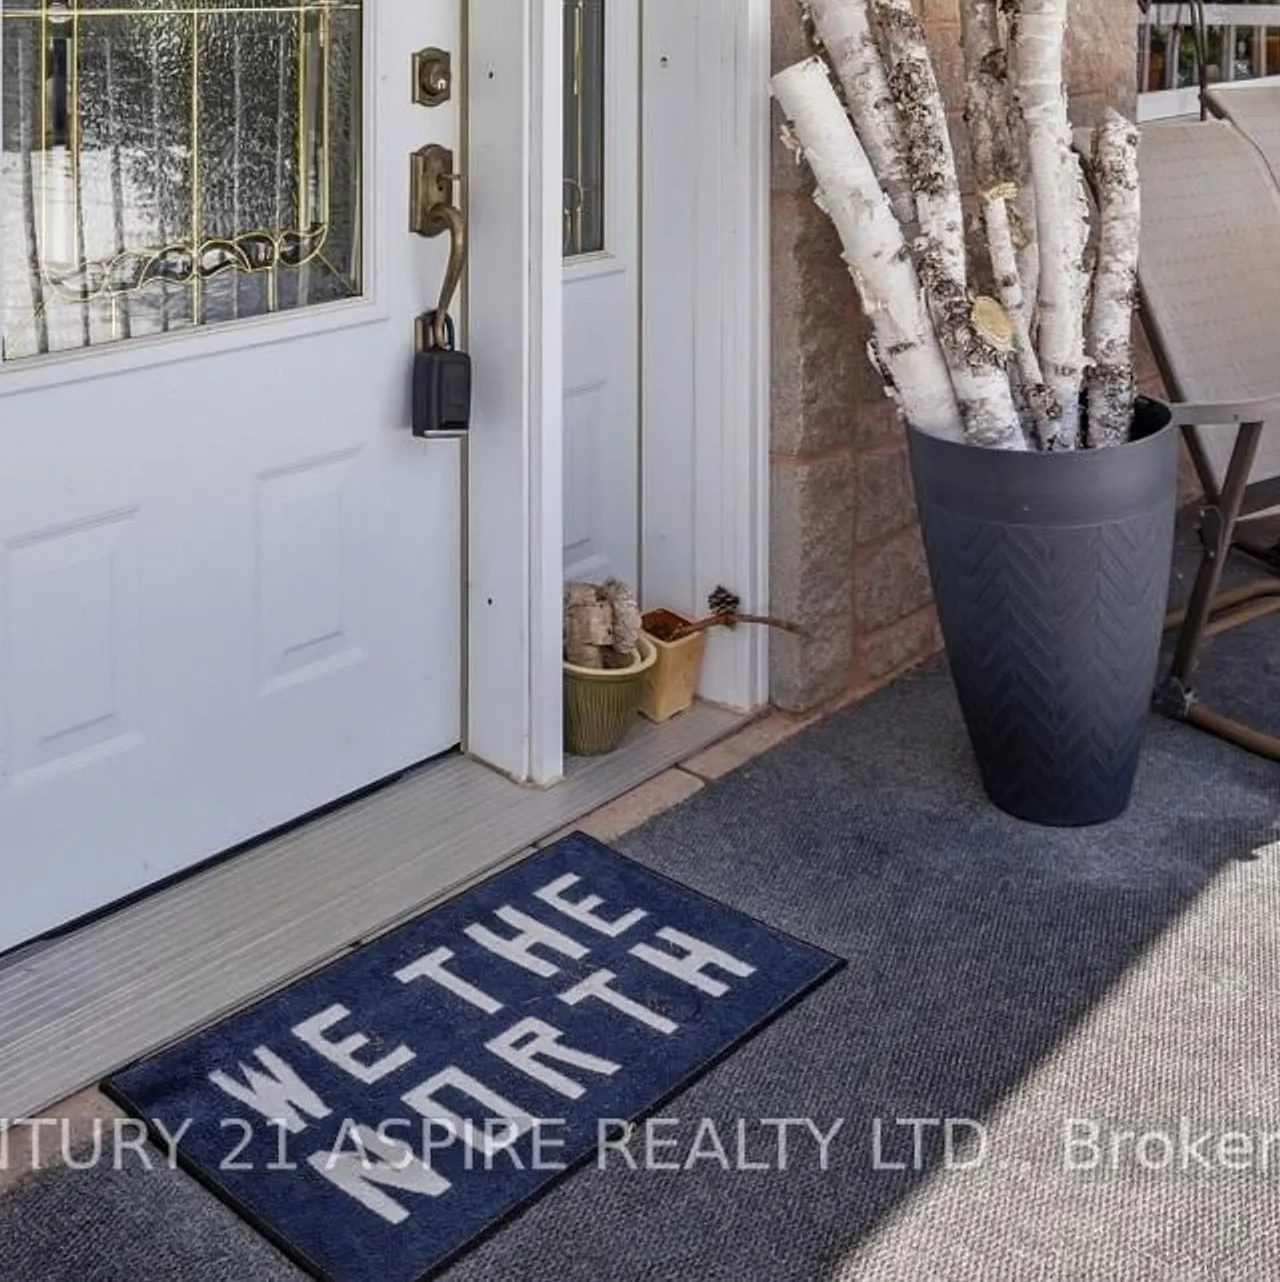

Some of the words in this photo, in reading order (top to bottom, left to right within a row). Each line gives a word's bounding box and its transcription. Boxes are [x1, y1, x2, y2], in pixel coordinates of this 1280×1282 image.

[208, 1003, 417, 1133] WE
[393, 872, 648, 1015] THE
[306, 926, 757, 1225] NORTH
